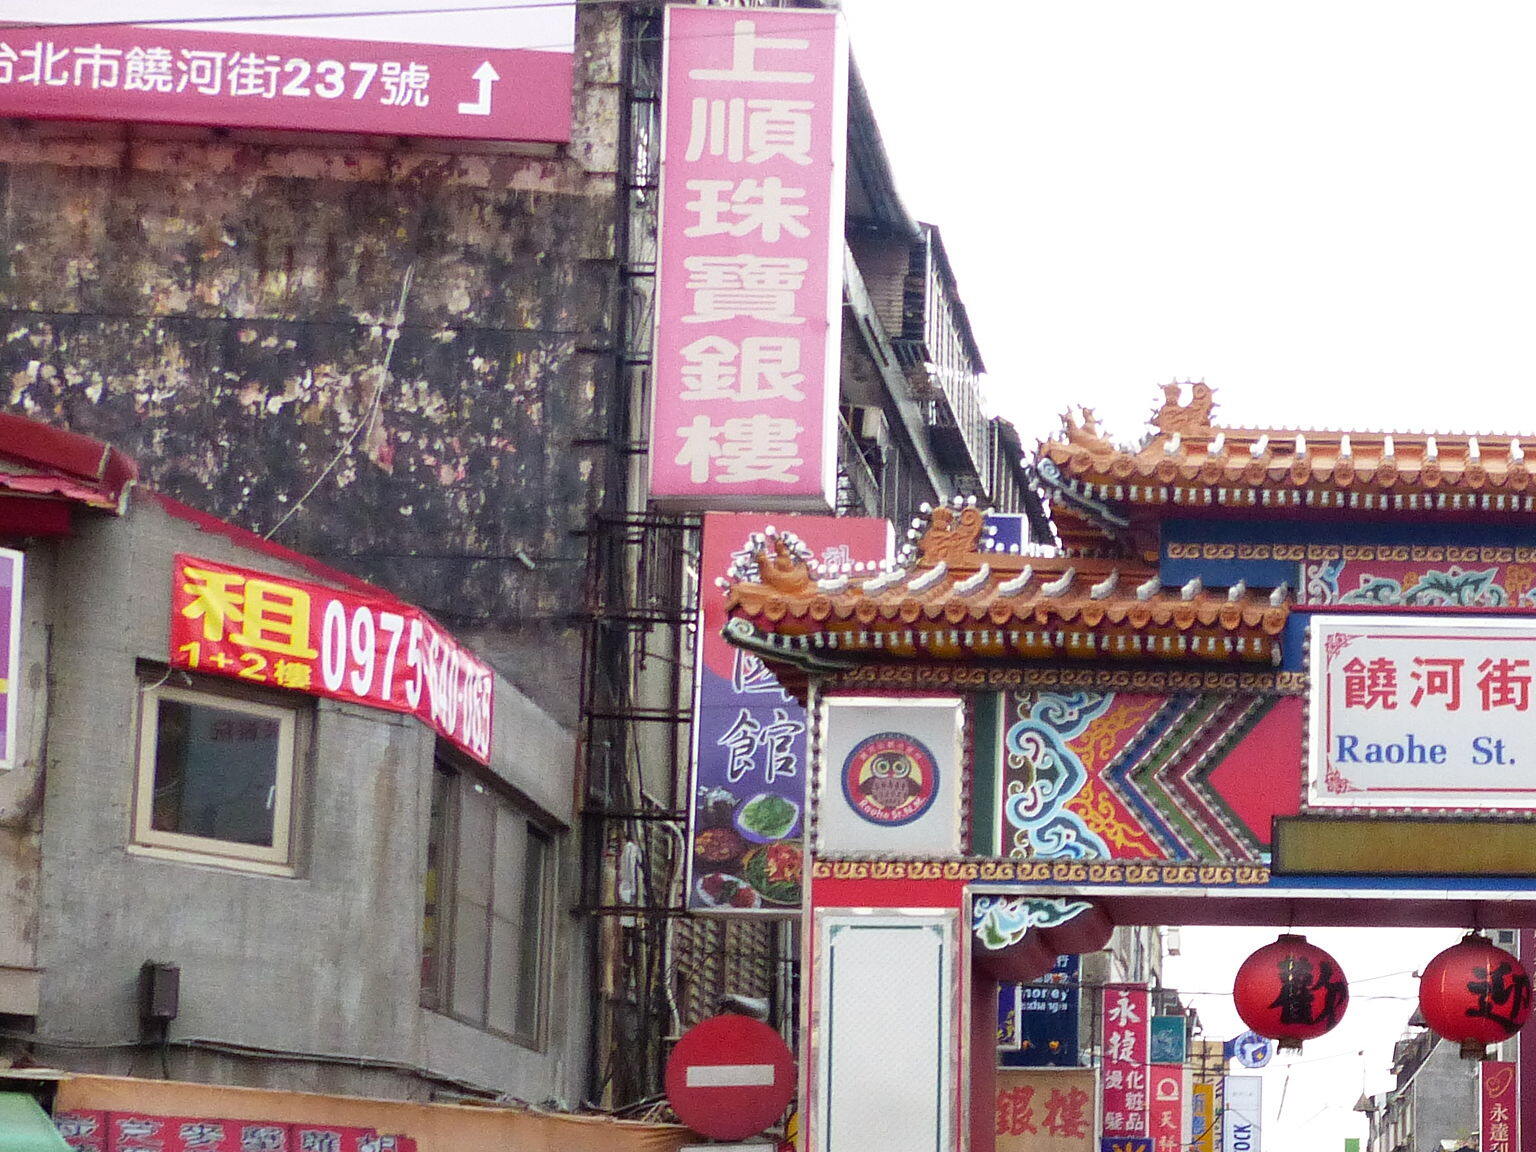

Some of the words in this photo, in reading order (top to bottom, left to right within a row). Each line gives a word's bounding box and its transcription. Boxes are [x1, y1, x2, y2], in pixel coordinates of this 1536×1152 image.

[676, 19, 816, 486] 上順珠寶銀樓
[182, 567, 319, 660] 租
[1335, 735, 1447, 766] Raohe
[1471, 736, 1516, 766] St.
[1466, 961, 1531, 1034] 迎
